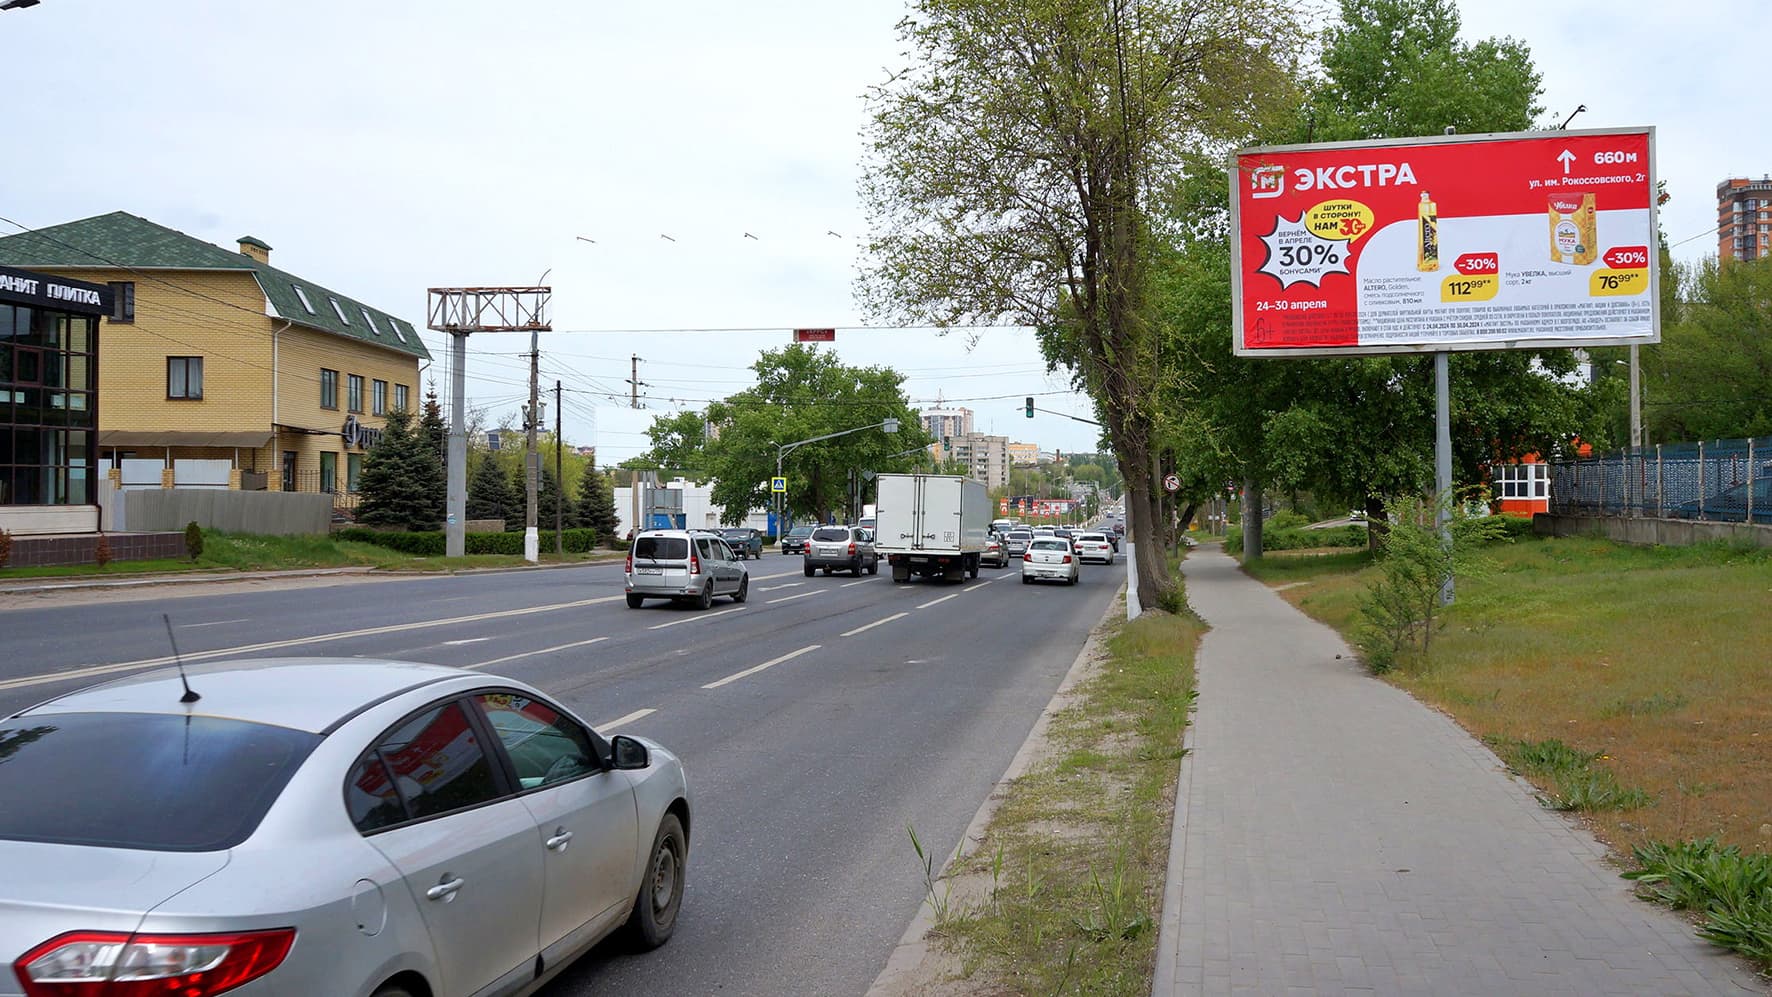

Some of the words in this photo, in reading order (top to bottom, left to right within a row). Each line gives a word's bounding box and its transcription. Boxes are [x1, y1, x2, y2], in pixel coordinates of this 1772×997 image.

[1294, 163, 1418, 191] ЭКСТРА
[1529, 179, 1542, 189] ул.
[1545, 178, 1560, 187] им.
[1562, 174, 1634, 186] Рокоссовского,
[1323, 203, 1352, 211] ШУТКИ
[1320, 211, 1361, 219] СТОРОНУ!
[1314, 222, 1338, 231] НАМ
[1278, 229, 1307, 238] ВЕРНЁМ
[1284, 237, 1313, 245] АПРЕЛЕ
[1279, 244, 1339, 267] 30%
[46, 283, 101, 306] ПЛИТКА
[1290, 300, 1327, 312] апреля
